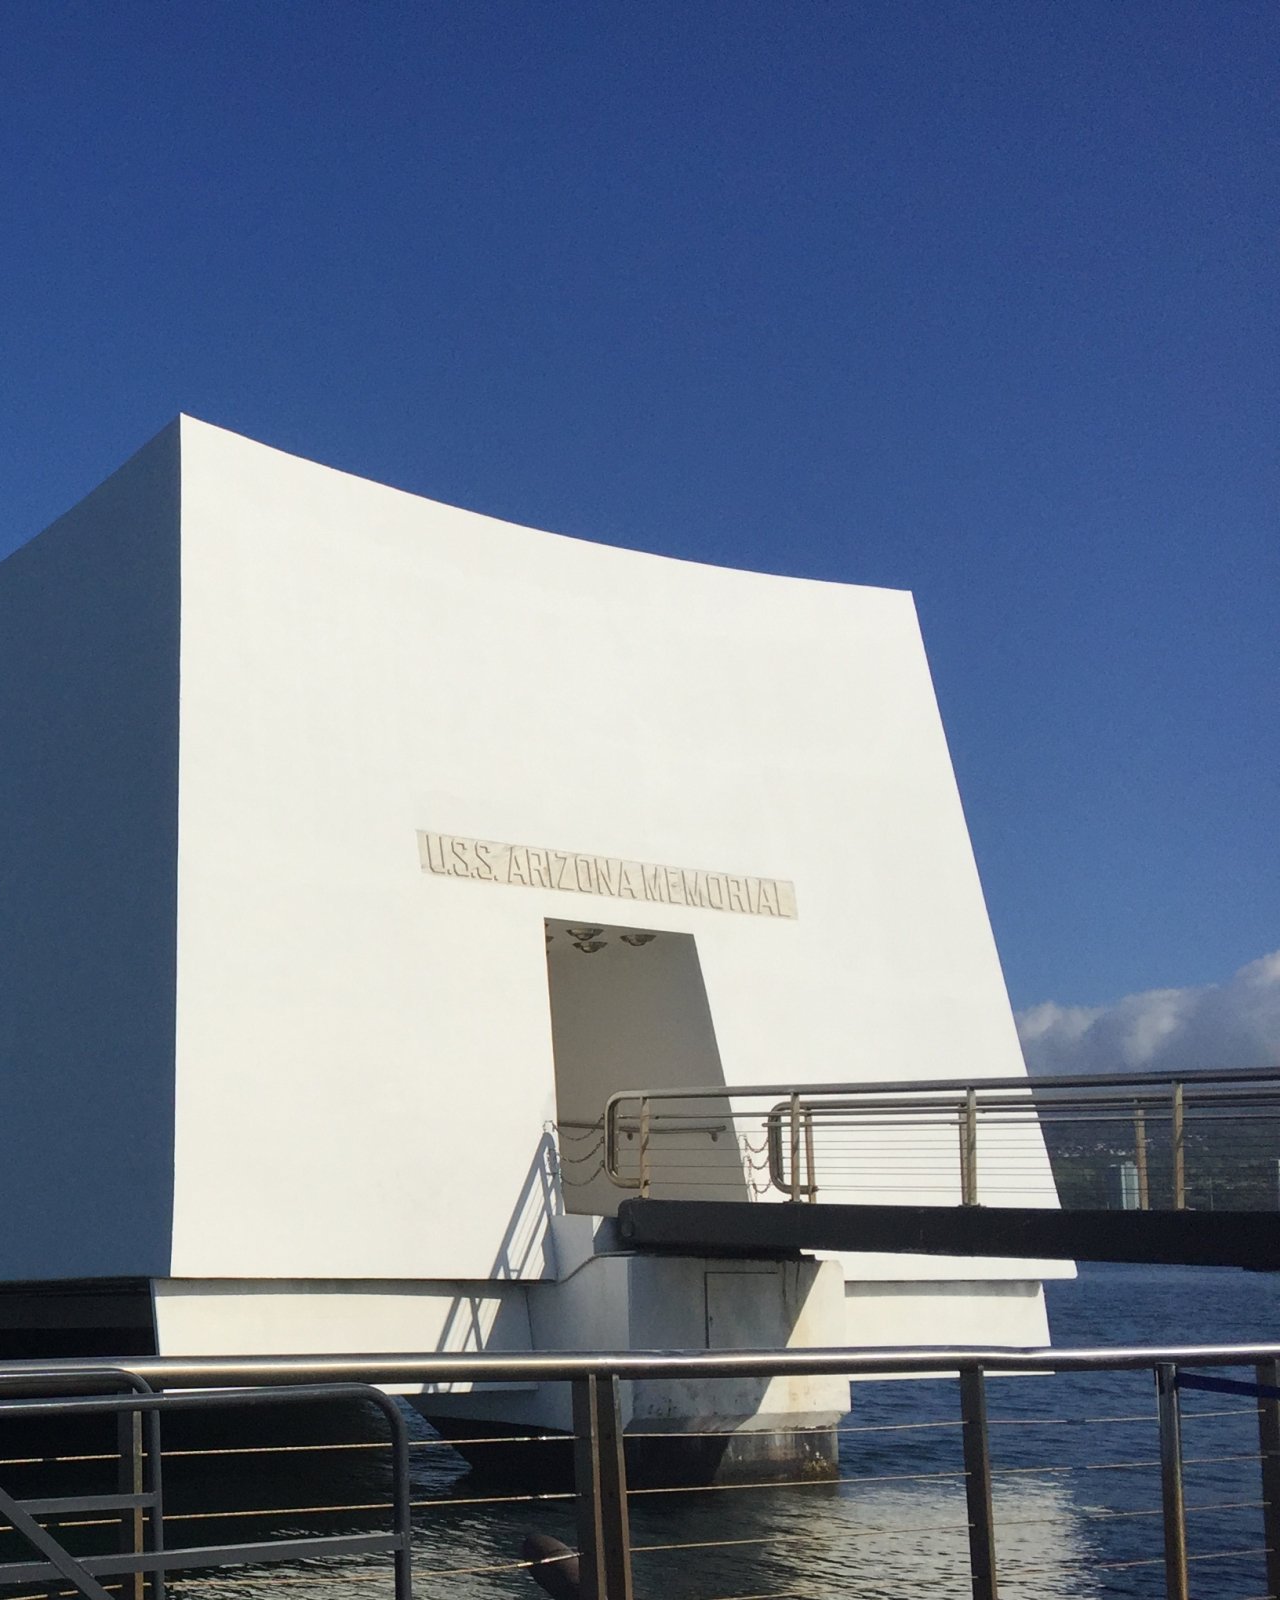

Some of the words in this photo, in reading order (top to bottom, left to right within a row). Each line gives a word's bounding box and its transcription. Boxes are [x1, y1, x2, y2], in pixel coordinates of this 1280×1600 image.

[426, 834, 499, 882] U.S.S.
[508, 846, 638, 900] ARIZONA
[641, 864, 792, 918] MEMORIAL
